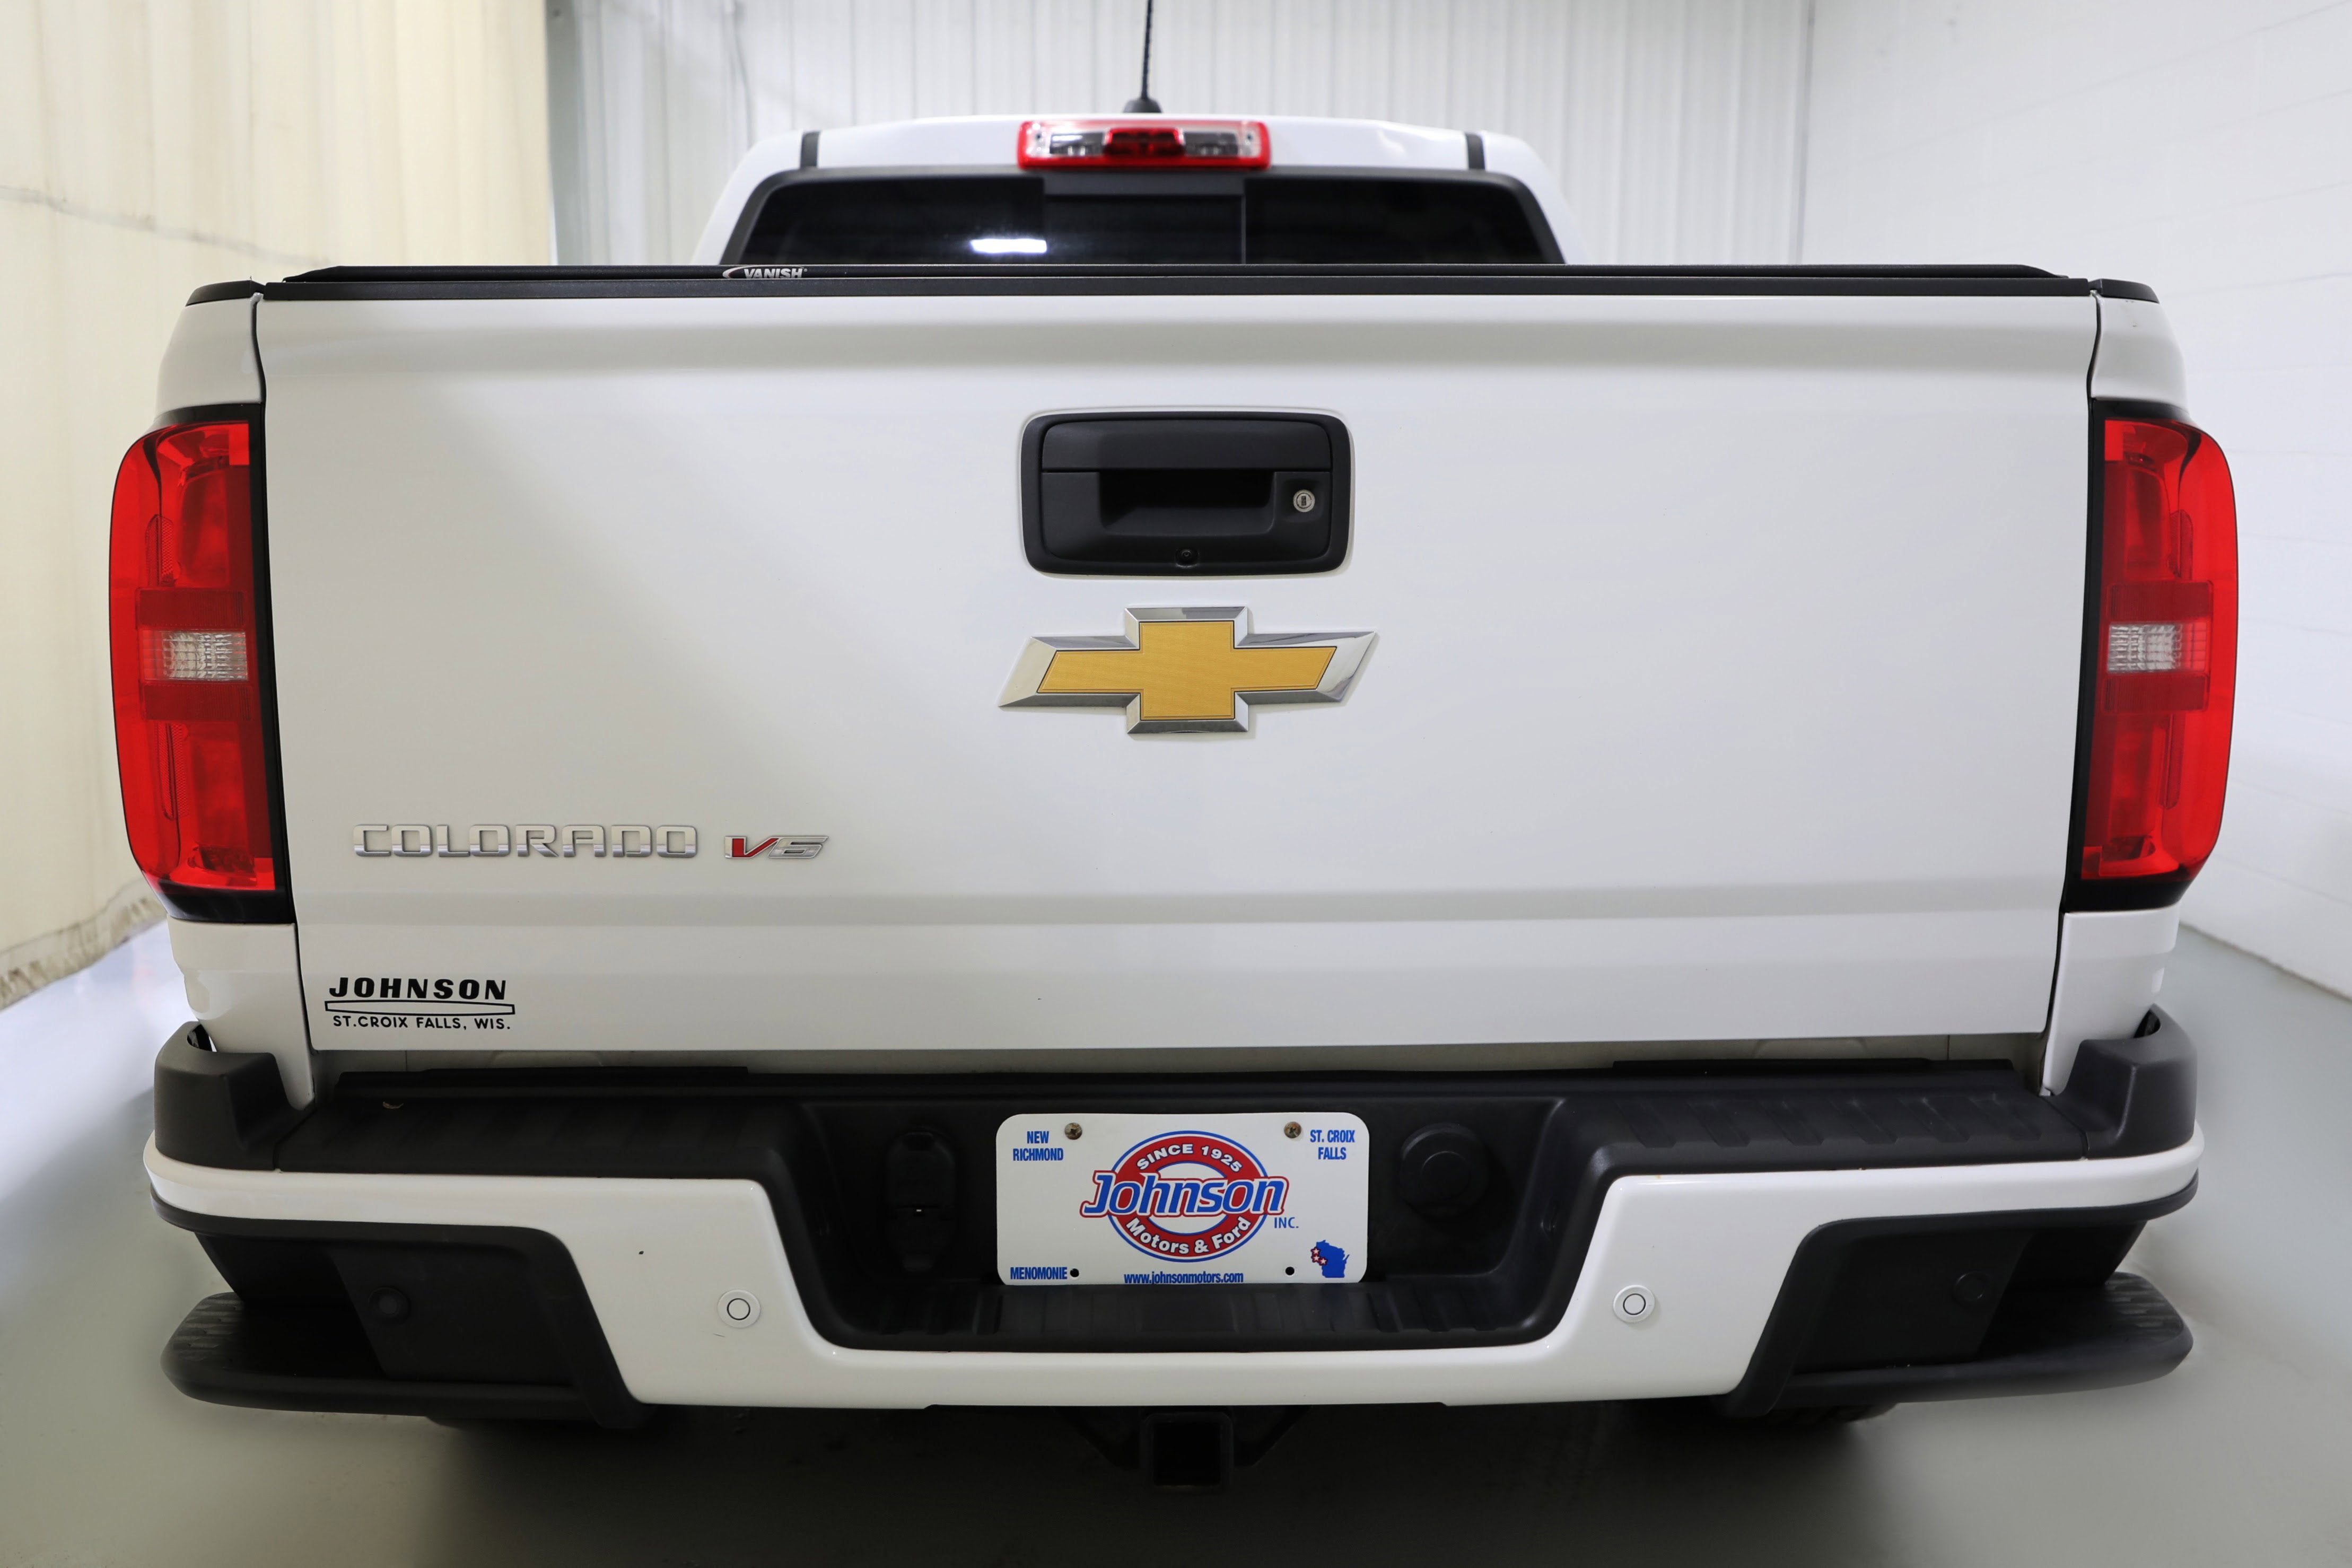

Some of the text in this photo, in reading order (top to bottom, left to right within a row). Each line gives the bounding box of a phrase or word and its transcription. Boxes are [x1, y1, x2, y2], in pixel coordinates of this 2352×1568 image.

[744, 268, 803, 278] VANISH
[353, 824, 698, 858] COLORADO
[724, 835, 828, 859] V6
[329, 977, 506, 1000] JOHNSON
[416, 1016, 468, 1031] FALLS,
[474, 1018, 511, 1030] WIS.
[1027, 1131, 1050, 1144] NEW
[1310, 1129, 1355, 1143] ST. CROIX
[1012, 1148, 1063, 1161] RICHMOND
[1136, 1143, 1242, 1173] SINCE 1925
[1318, 1147, 1347, 1160] FALLS
[1083, 1175, 1286, 1214] Johnson
[1274, 1217, 1299, 1229] INC.
[1125, 1216, 1252, 1255] Motors & Ford
[1010, 1267, 1068, 1280] MENOMONIE
[1124, 1272, 1244, 1284] www.johnsonmotors.com
